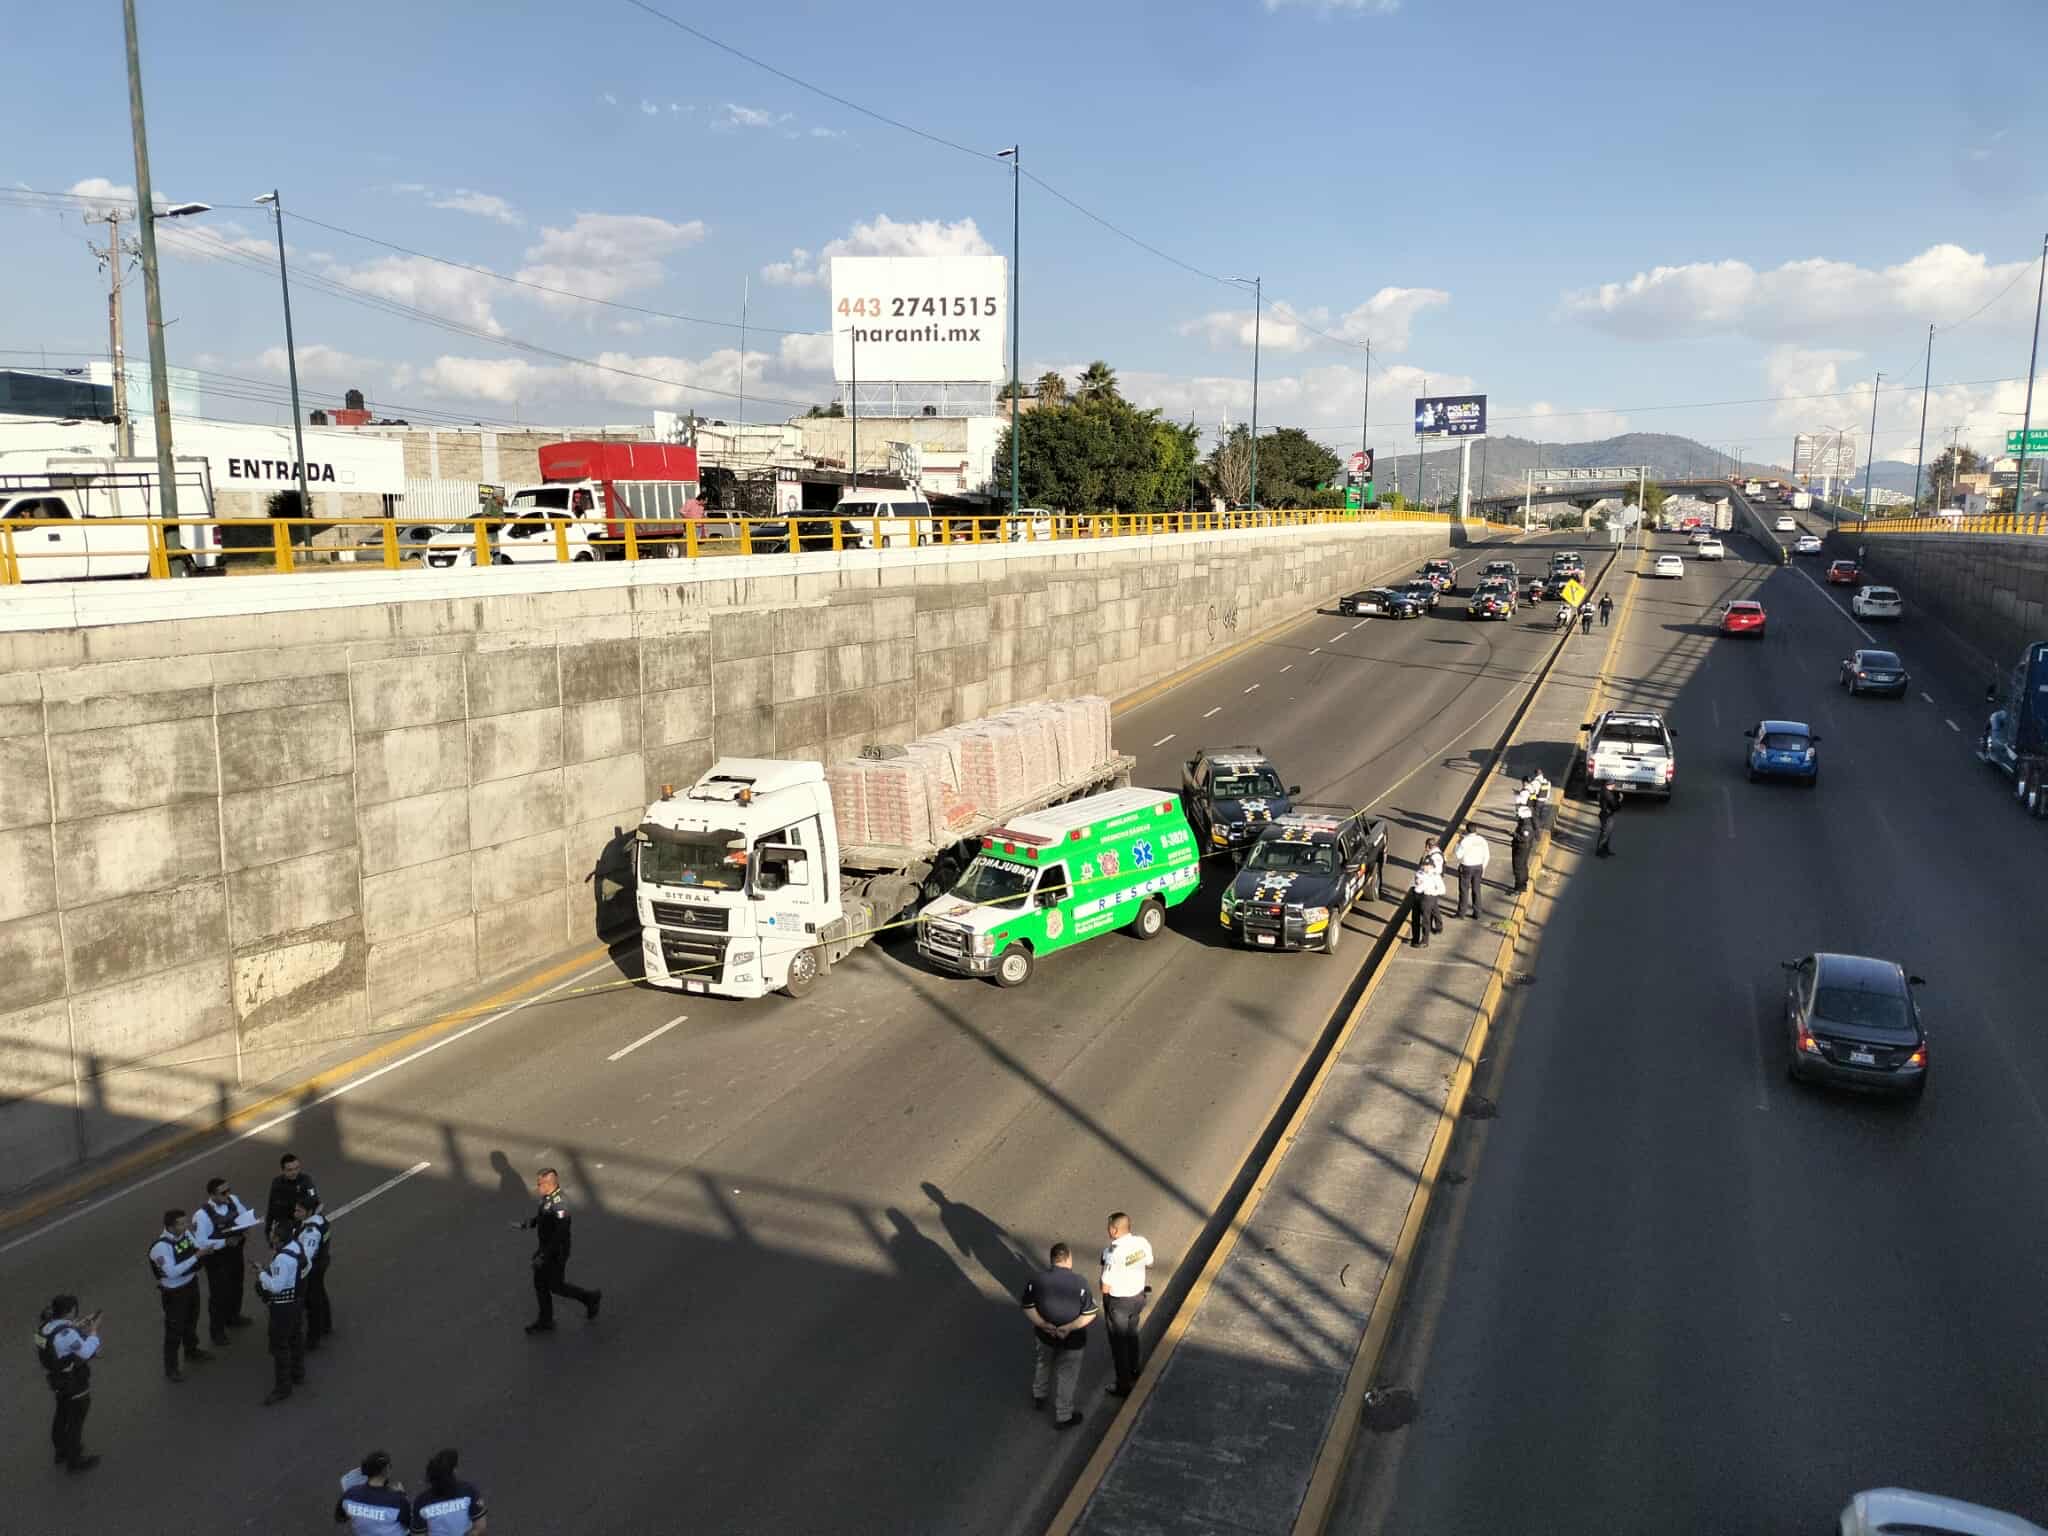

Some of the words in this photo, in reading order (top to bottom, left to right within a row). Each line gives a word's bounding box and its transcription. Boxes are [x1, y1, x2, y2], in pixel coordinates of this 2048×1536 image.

[837, 297, 881, 317] 443
[891, 297, 997, 317] 2741515
[855, 324, 981, 342] naranti.mx
[228, 458, 336, 482] ENTRADA
[664, 891, 710, 902] SITRAK
[1098, 866, 1190, 910] RESCATE
